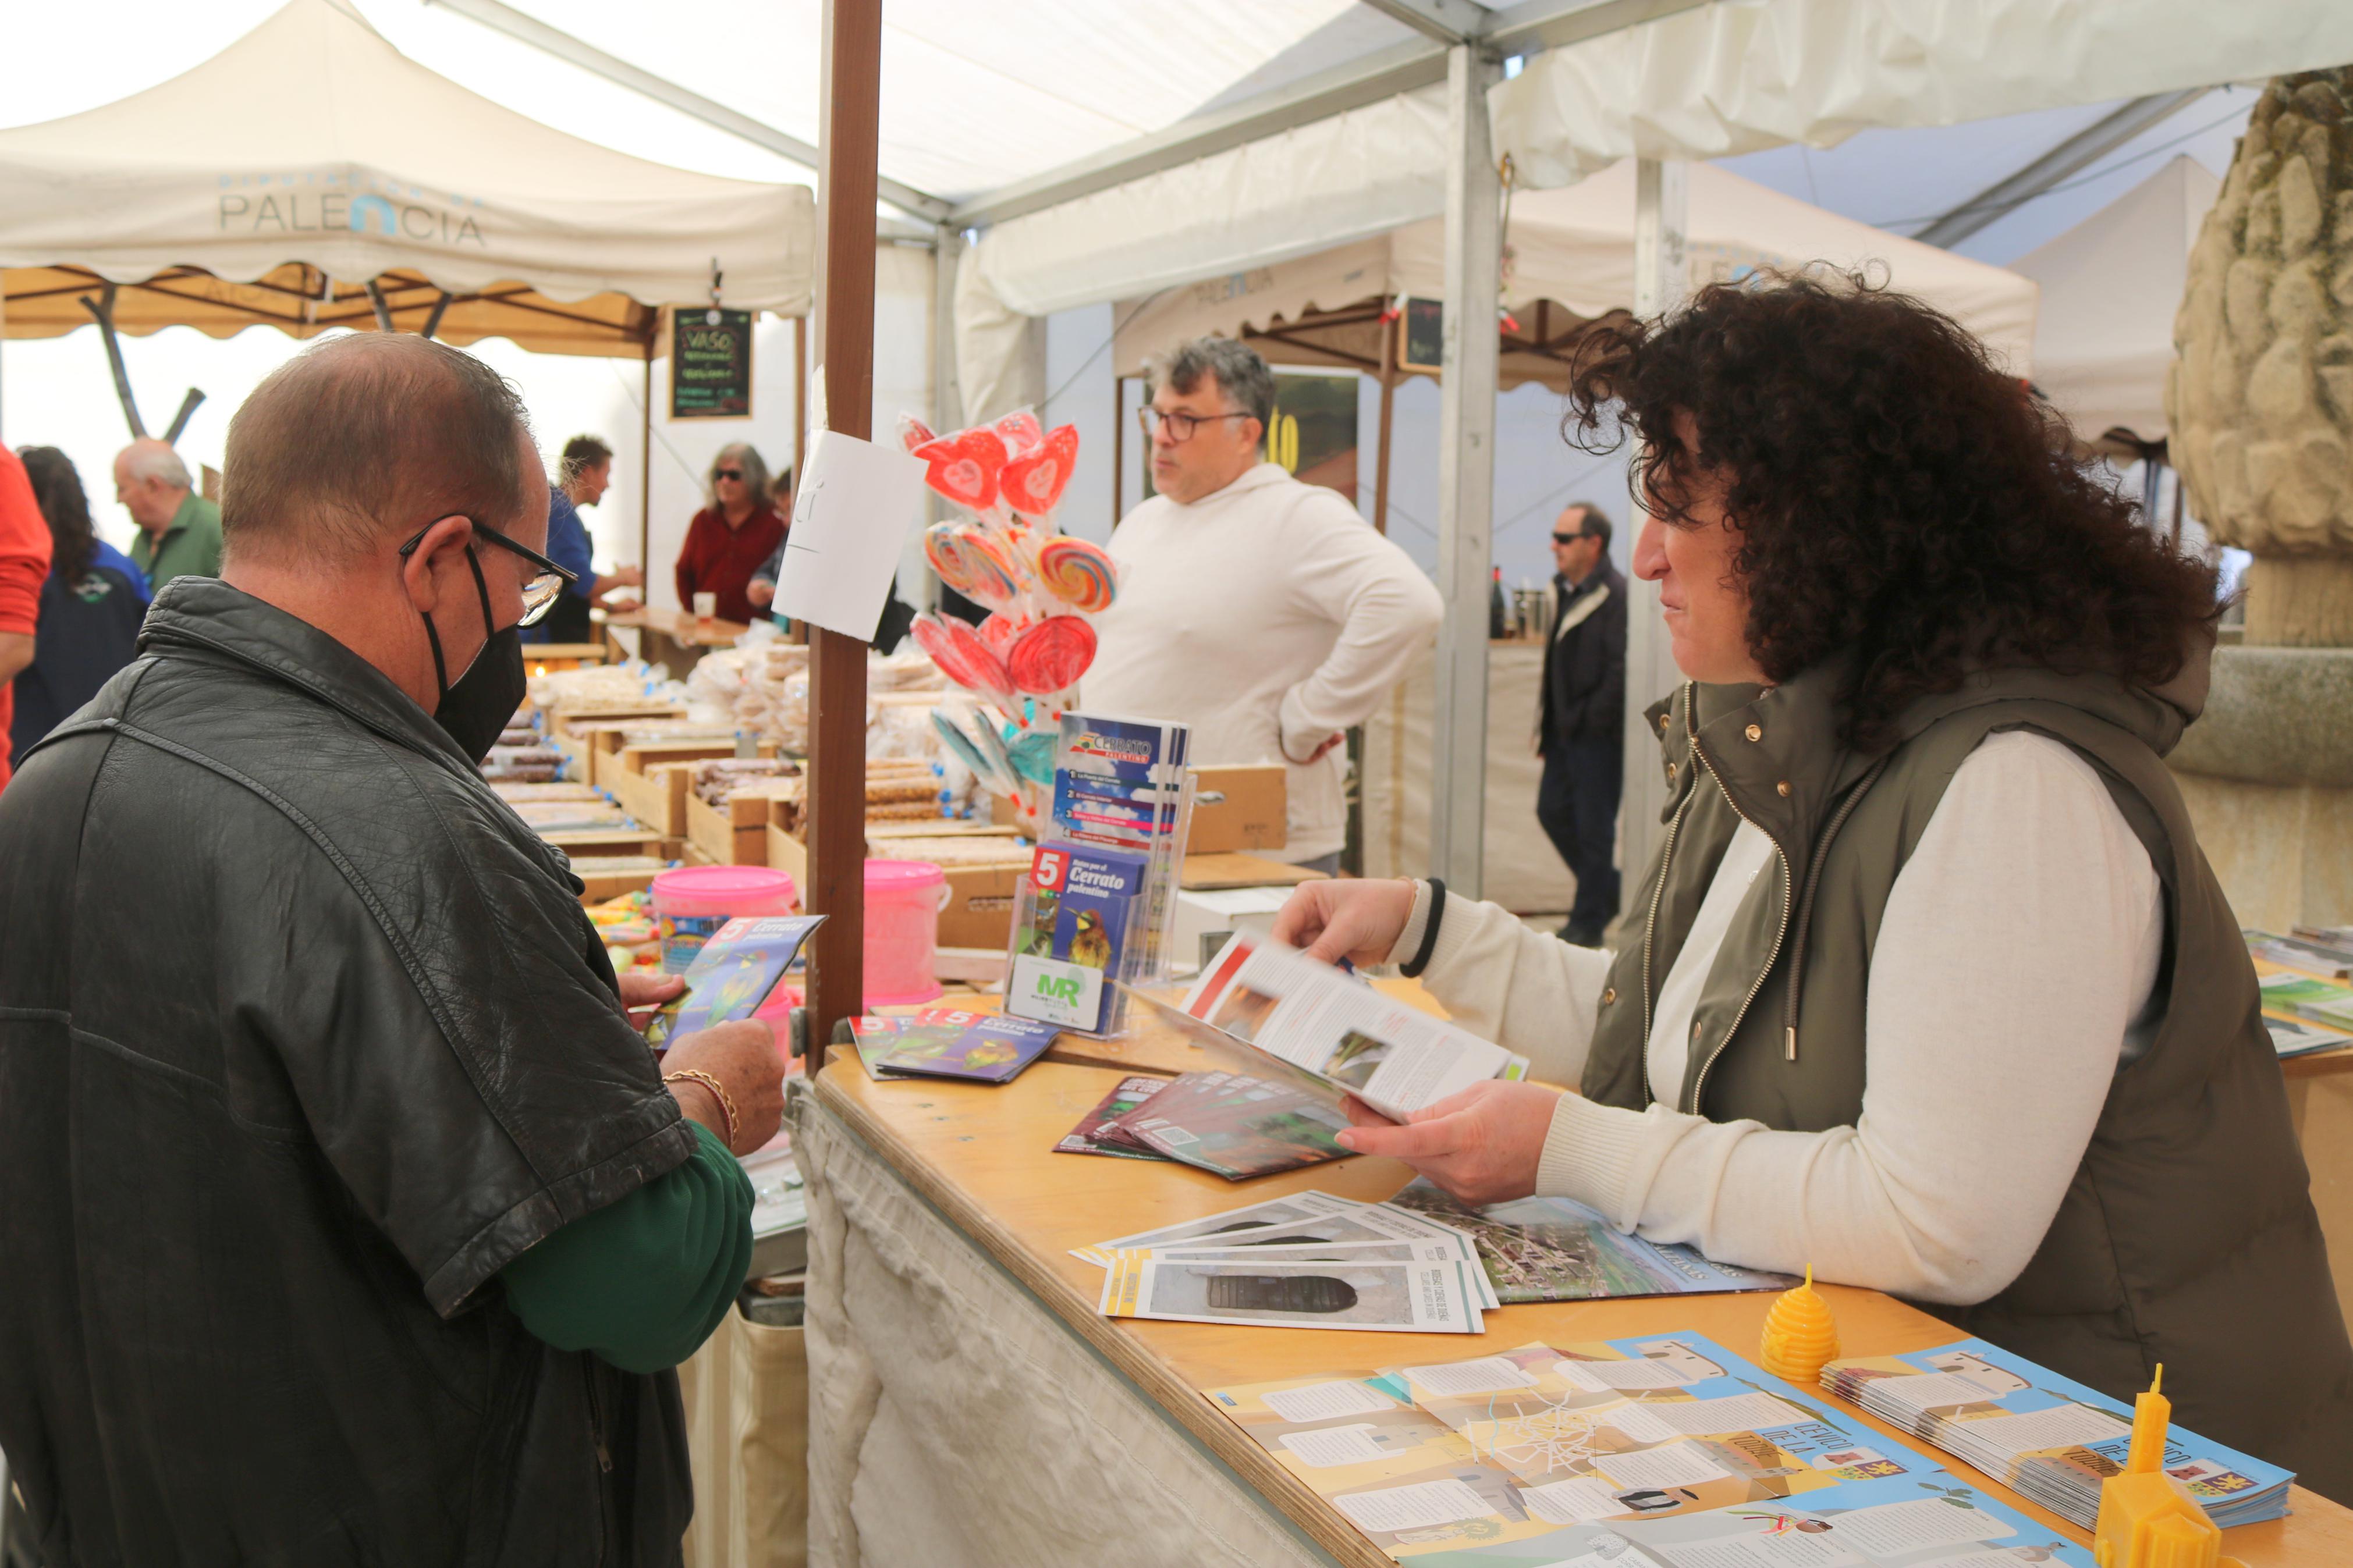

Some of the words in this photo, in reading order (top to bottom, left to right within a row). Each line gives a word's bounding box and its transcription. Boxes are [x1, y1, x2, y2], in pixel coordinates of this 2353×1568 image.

[1094, 736, 1152, 755] CERRATO
[1106, 751, 1147, 763] PALENTINO
[1067, 790, 1074, 798] 2
[1066, 809, 1072, 818] 3
[1037, 852, 1060, 887] 5
[1070, 866, 1125, 890] Cerrato
[1066, 883, 1110, 898] palentino
[720, 918, 752, 941] 5
[752, 922, 804, 932] Cerrato
[1037, 974, 1080, 1008] MR
[861, 1016, 885, 1031] 5
[945, 1011, 974, 1024] 5
[1761, 1430, 1798, 1442] DE
[1780, 1441, 1816, 1454] LA
[1794, 1424, 1854, 1450] CEVICO
[2093, 1445, 2128, 1457] DE
